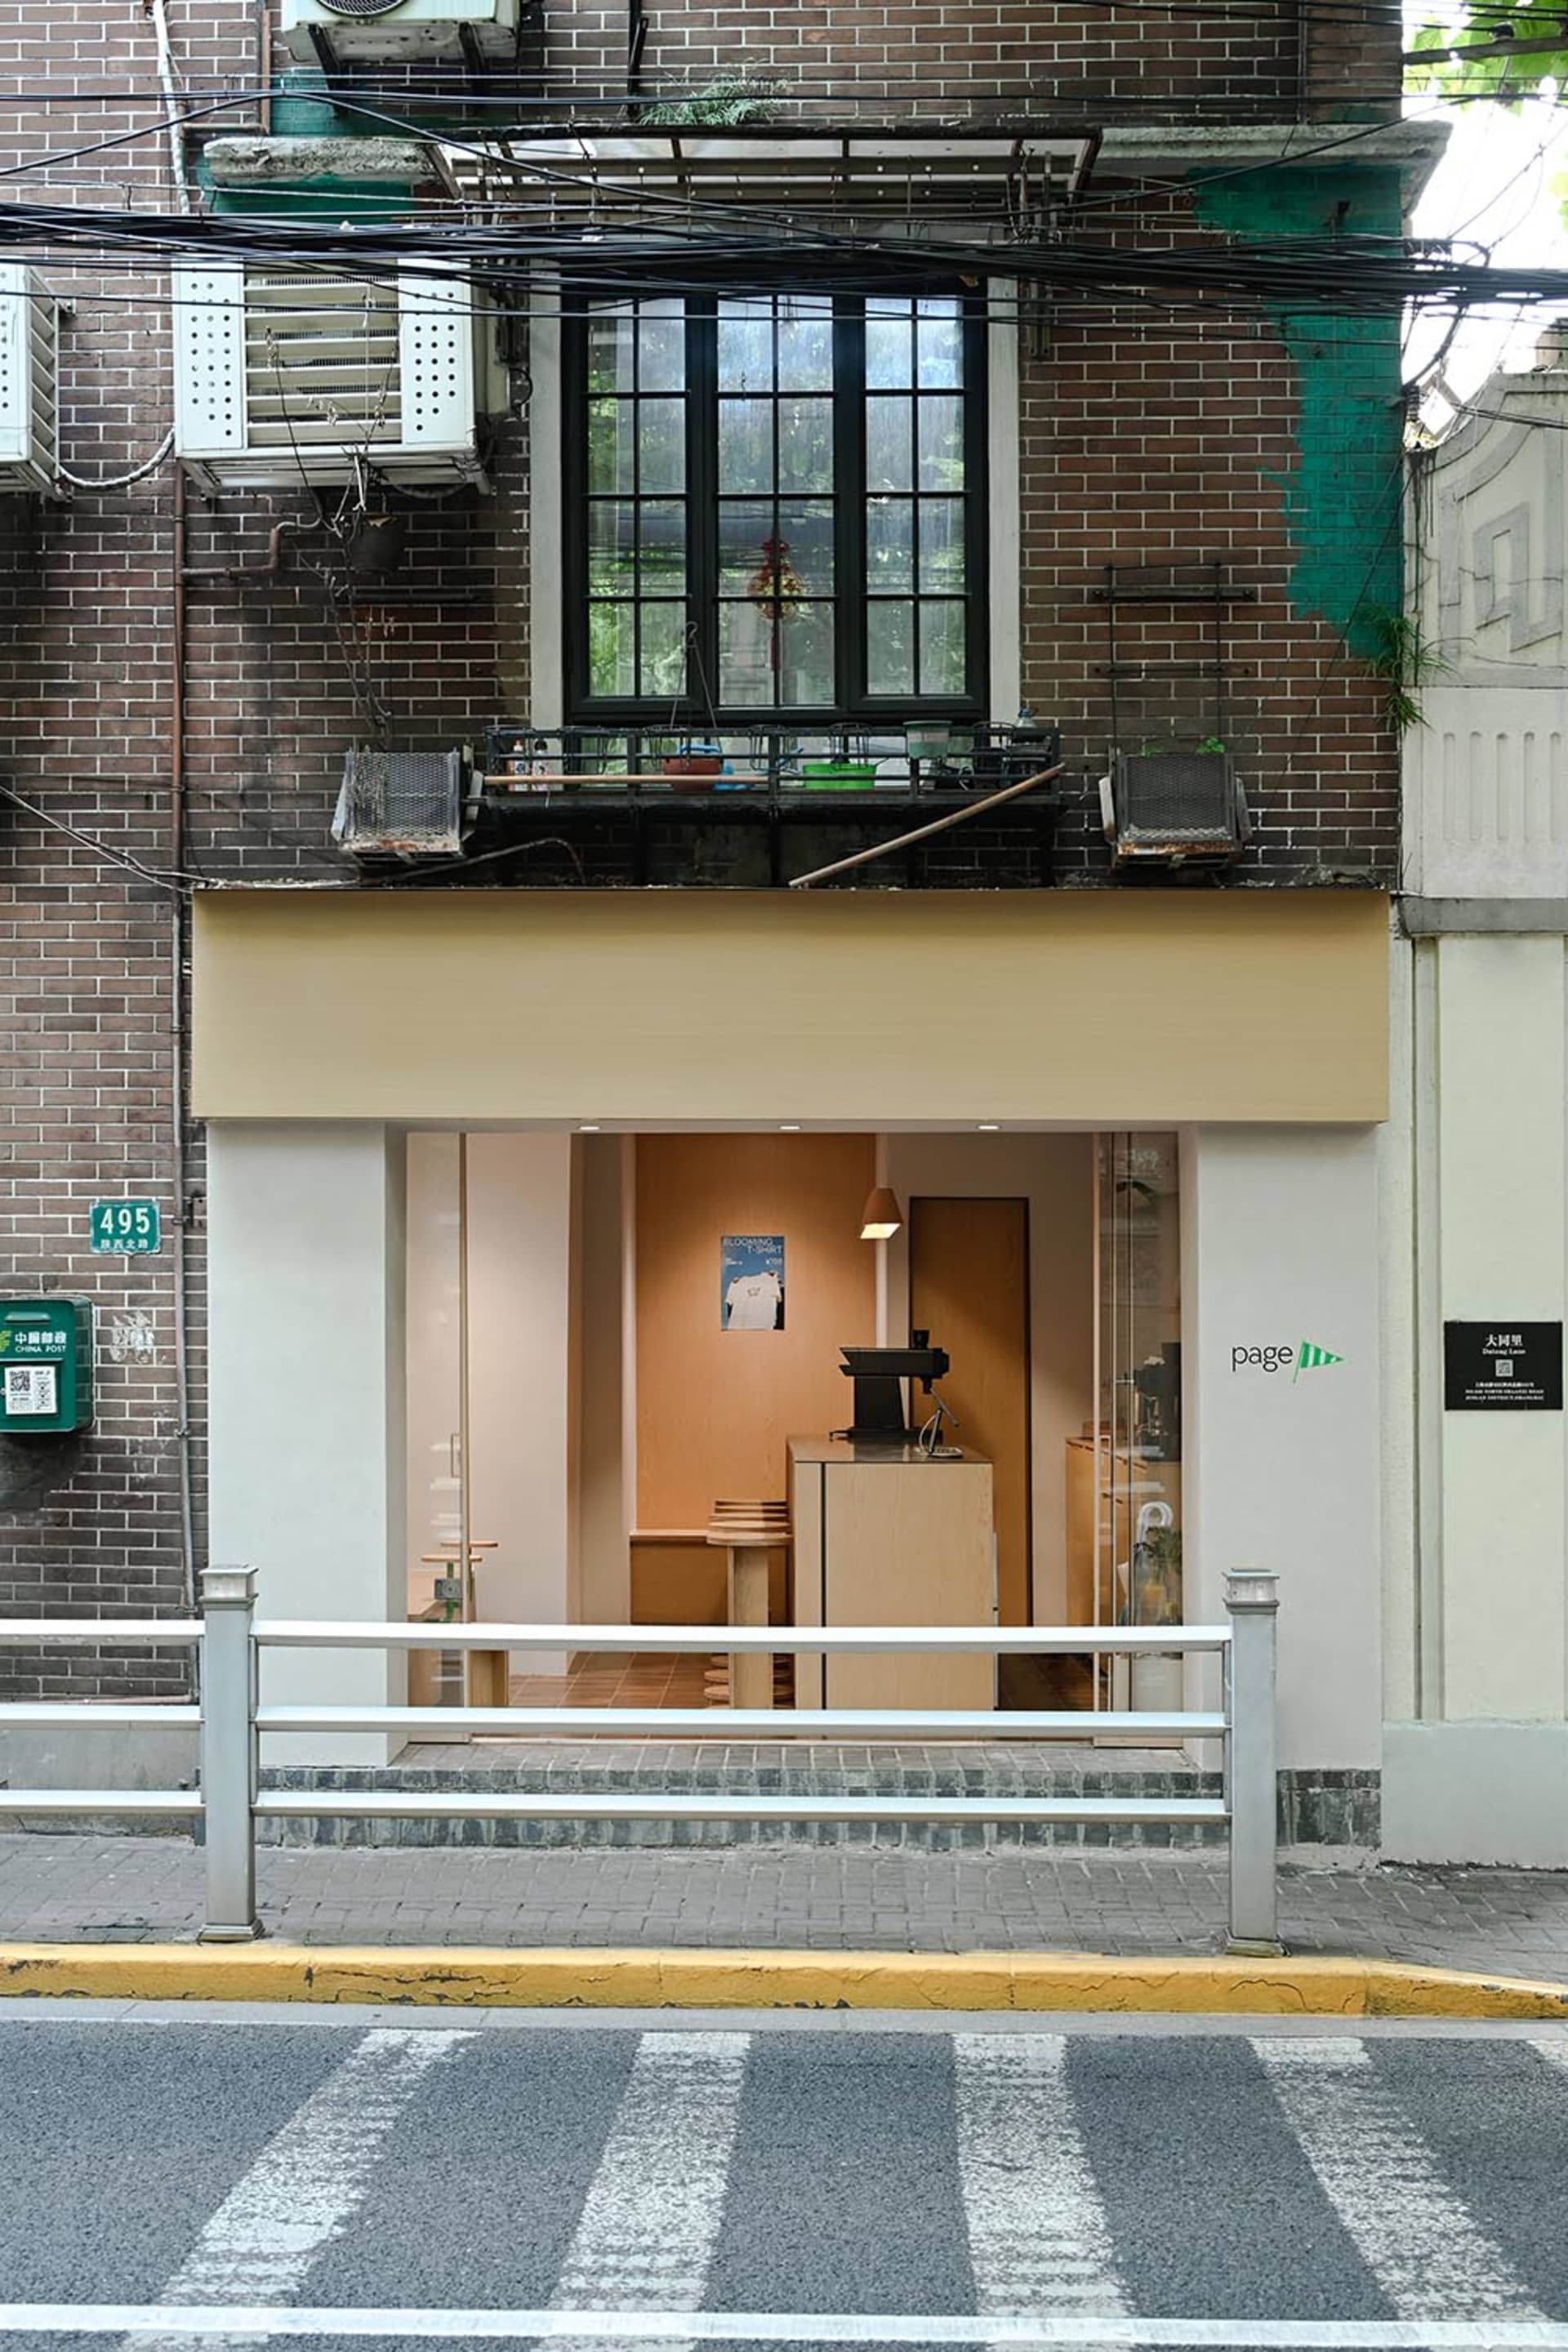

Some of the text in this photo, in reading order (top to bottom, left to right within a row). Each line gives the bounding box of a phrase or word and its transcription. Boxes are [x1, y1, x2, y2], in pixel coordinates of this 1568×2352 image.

[100, 1208, 149, 1234] 495
[747, 1245, 782, 1254] T-SHIRT
[1232, 1346, 1293, 1373] page
